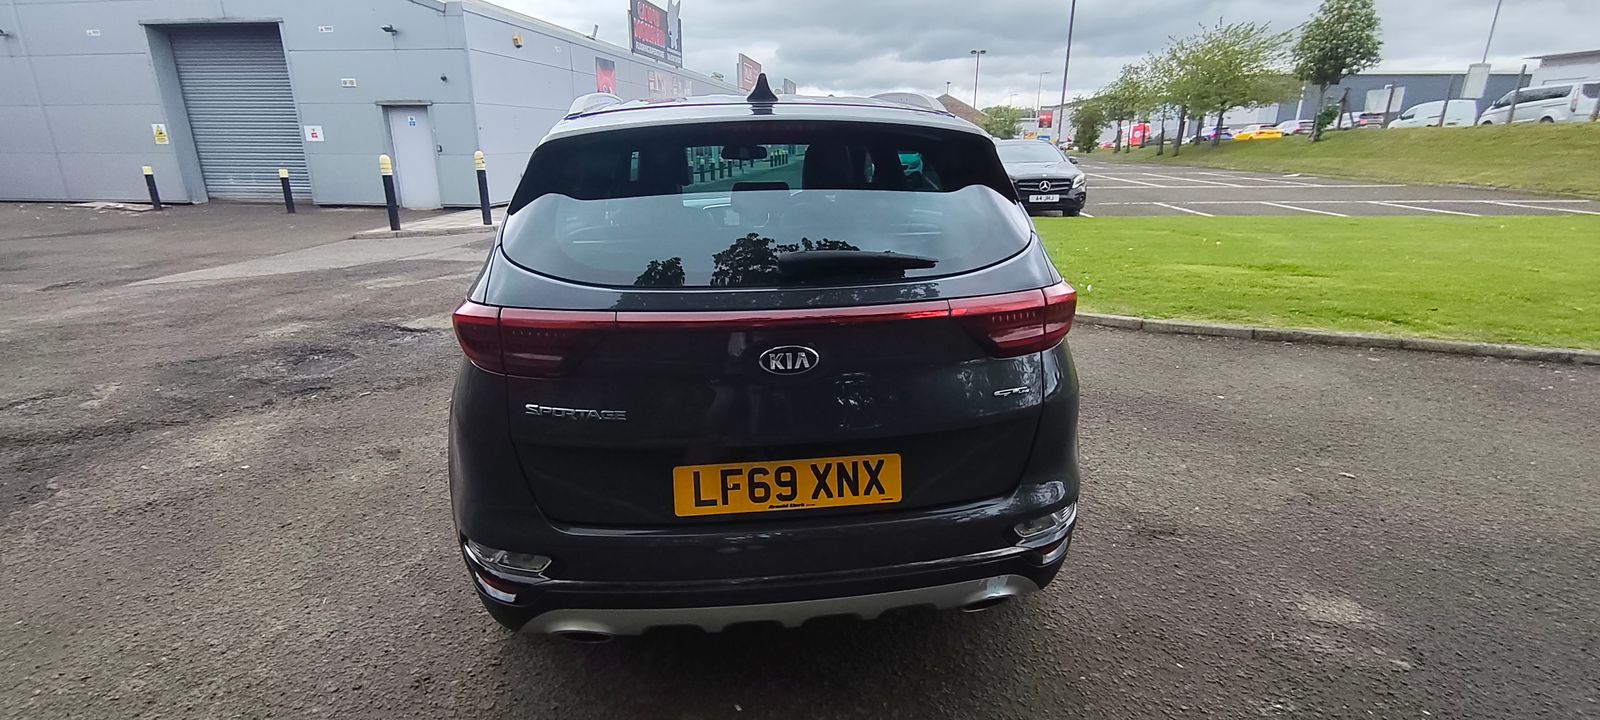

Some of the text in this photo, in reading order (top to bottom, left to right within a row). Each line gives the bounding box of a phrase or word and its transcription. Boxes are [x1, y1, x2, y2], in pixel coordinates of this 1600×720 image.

[769, 352, 810, 370] KIA
[525, 403, 627, 420] SPORTAGE
[692, 459, 886, 508] LF69 XNX
